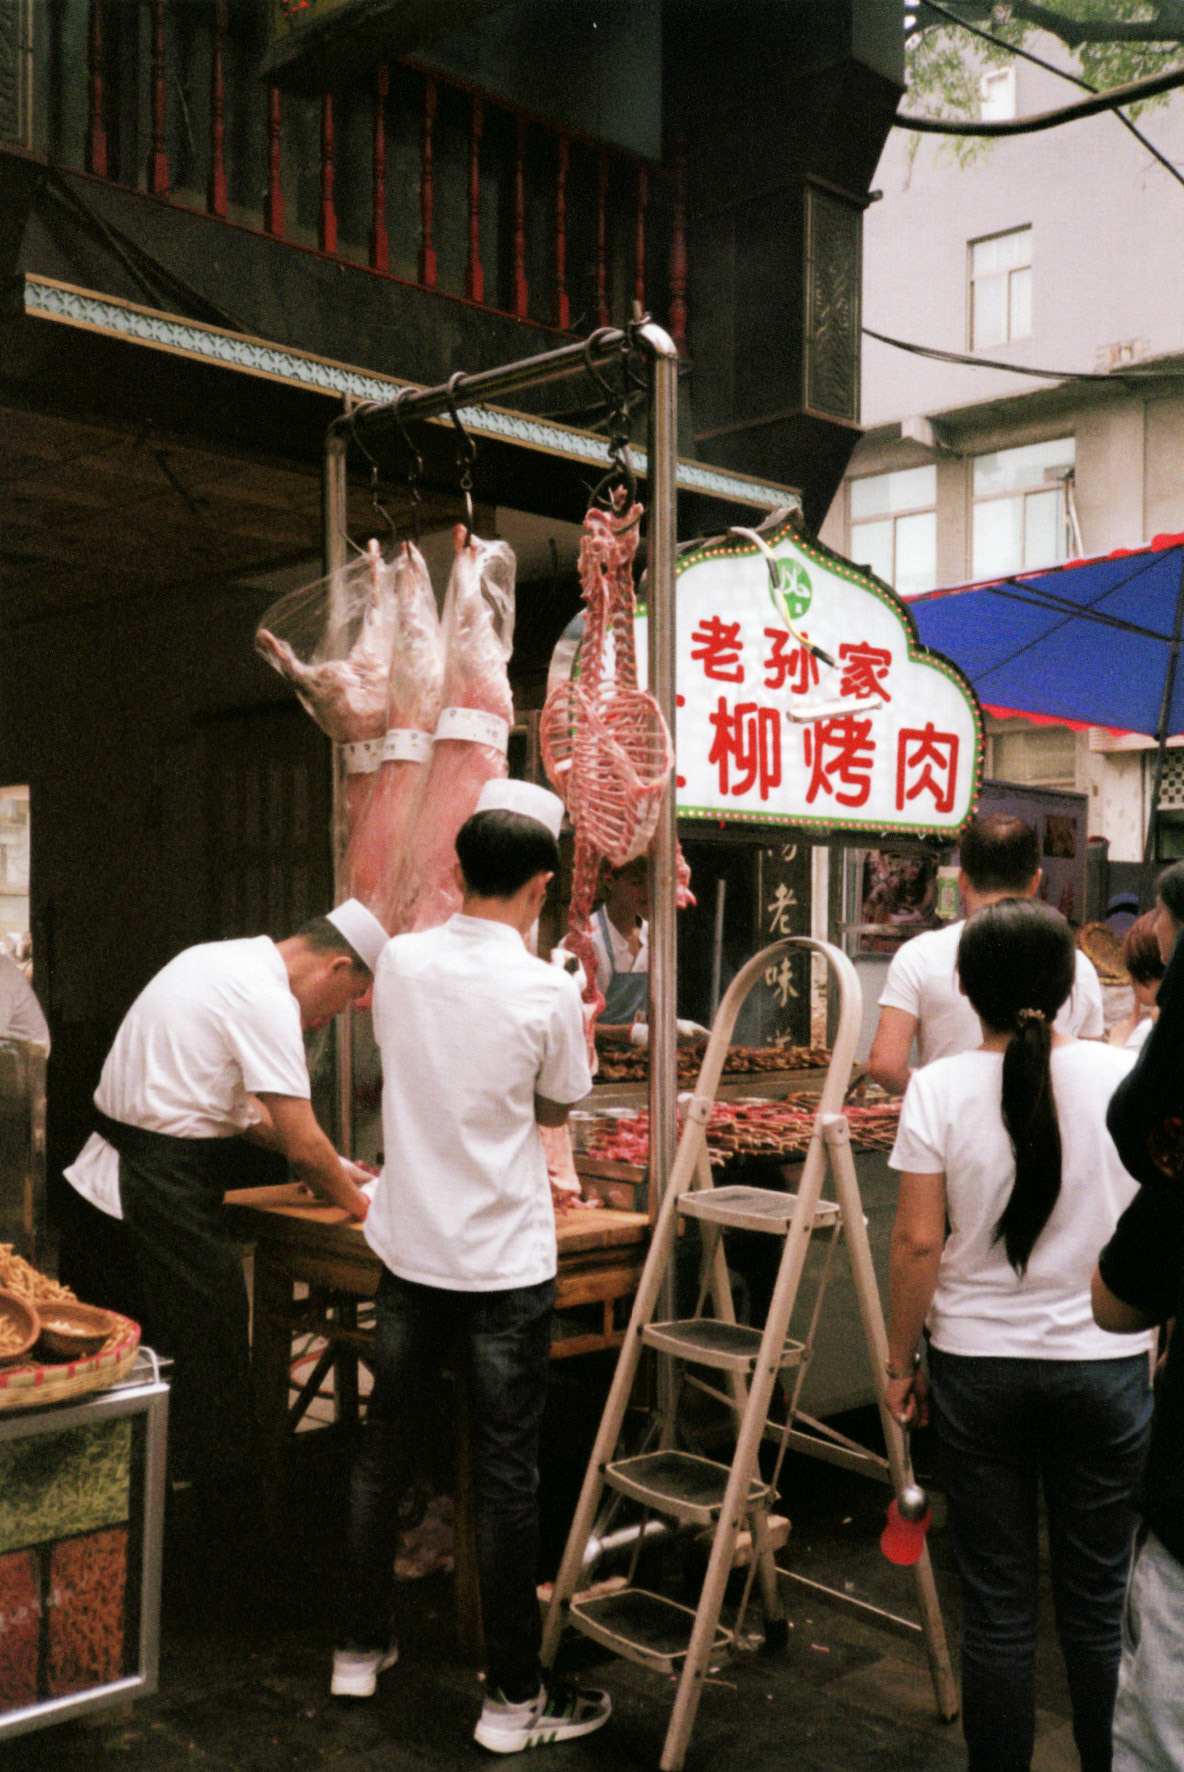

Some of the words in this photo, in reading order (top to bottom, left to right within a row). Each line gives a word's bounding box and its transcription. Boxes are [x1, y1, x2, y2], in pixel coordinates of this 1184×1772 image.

[691, 615, 892, 703] 老孙家
[676, 694, 960, 814] 柳烤肉
